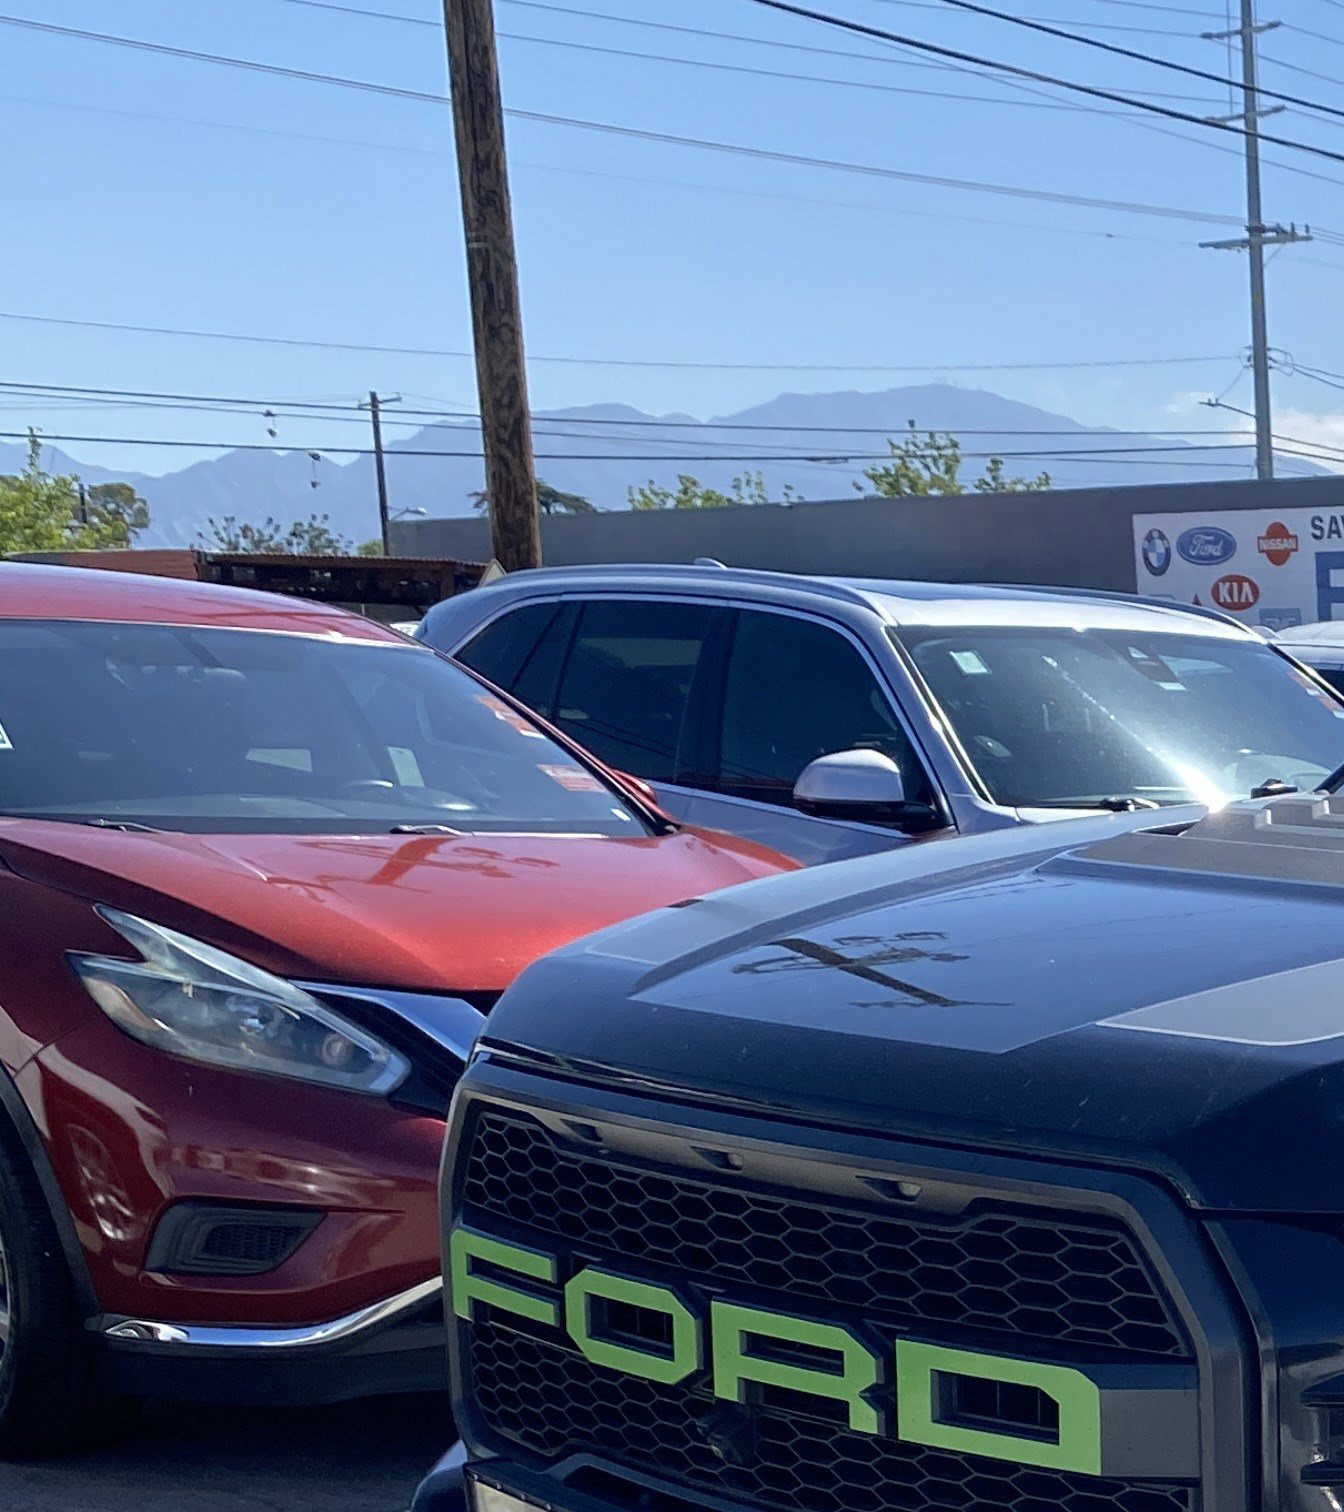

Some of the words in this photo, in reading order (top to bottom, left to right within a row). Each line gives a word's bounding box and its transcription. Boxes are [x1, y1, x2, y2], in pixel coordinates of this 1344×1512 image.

[1189, 533, 1224, 556] Ford
[1258, 537, 1296, 551] NISSAN
[1218, 581, 1254, 603] KIA
[450, 1228, 1102, 1476] FORD
